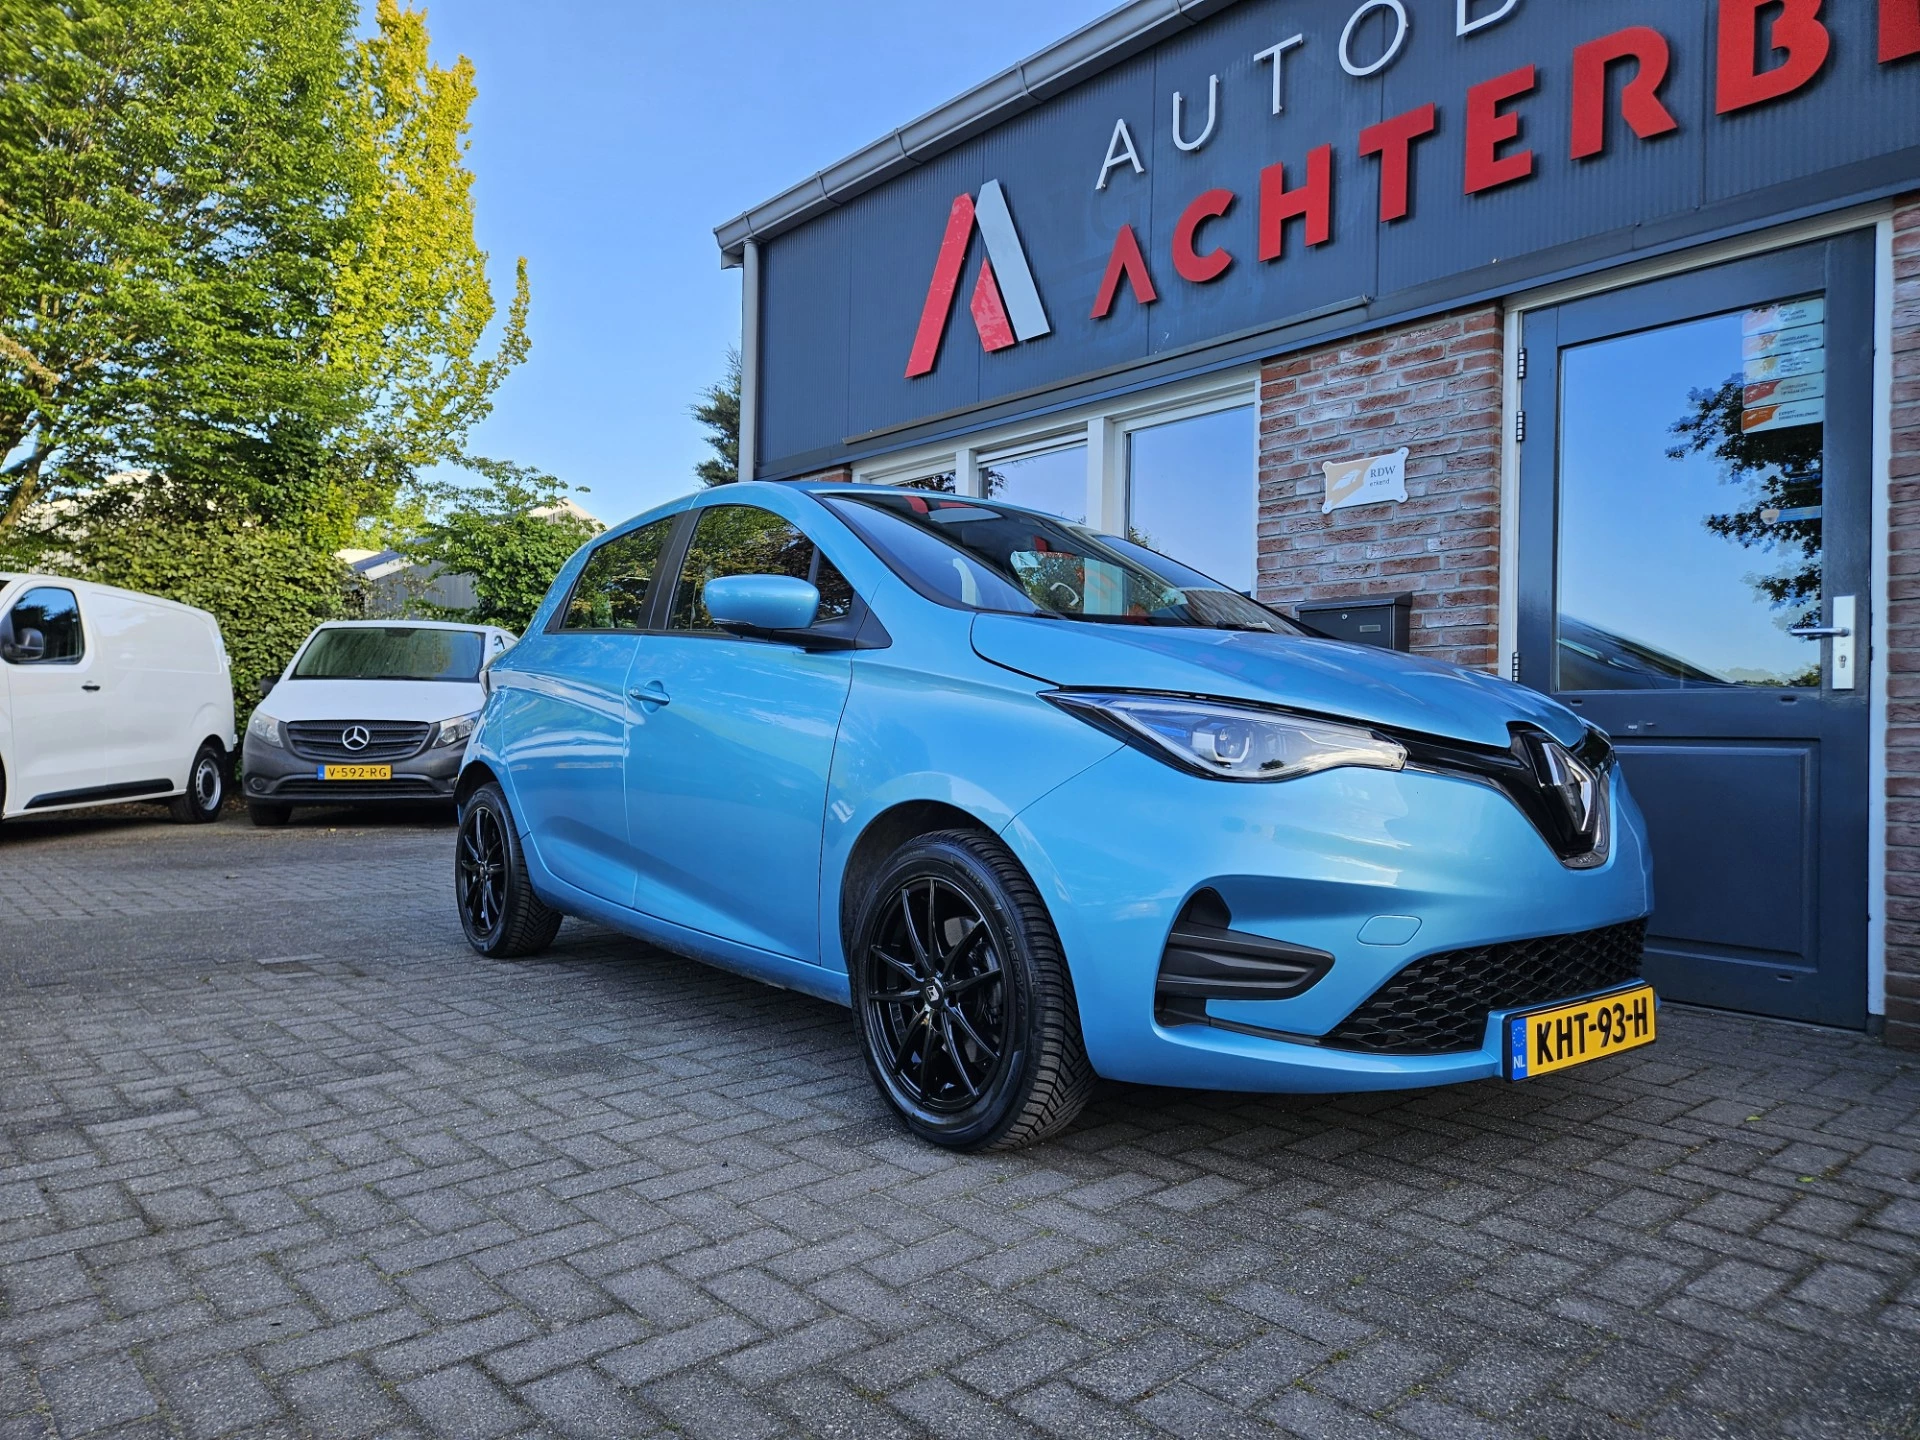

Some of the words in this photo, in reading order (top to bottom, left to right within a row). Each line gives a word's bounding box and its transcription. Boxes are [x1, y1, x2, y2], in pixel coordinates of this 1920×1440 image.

[1370, 466, 1396, 477] RDW
[328, 767, 387, 778] V-592-RG
[1536, 996, 1648, 1066] KHT-93-H
[1513, 1054, 1526, 1070] NL
